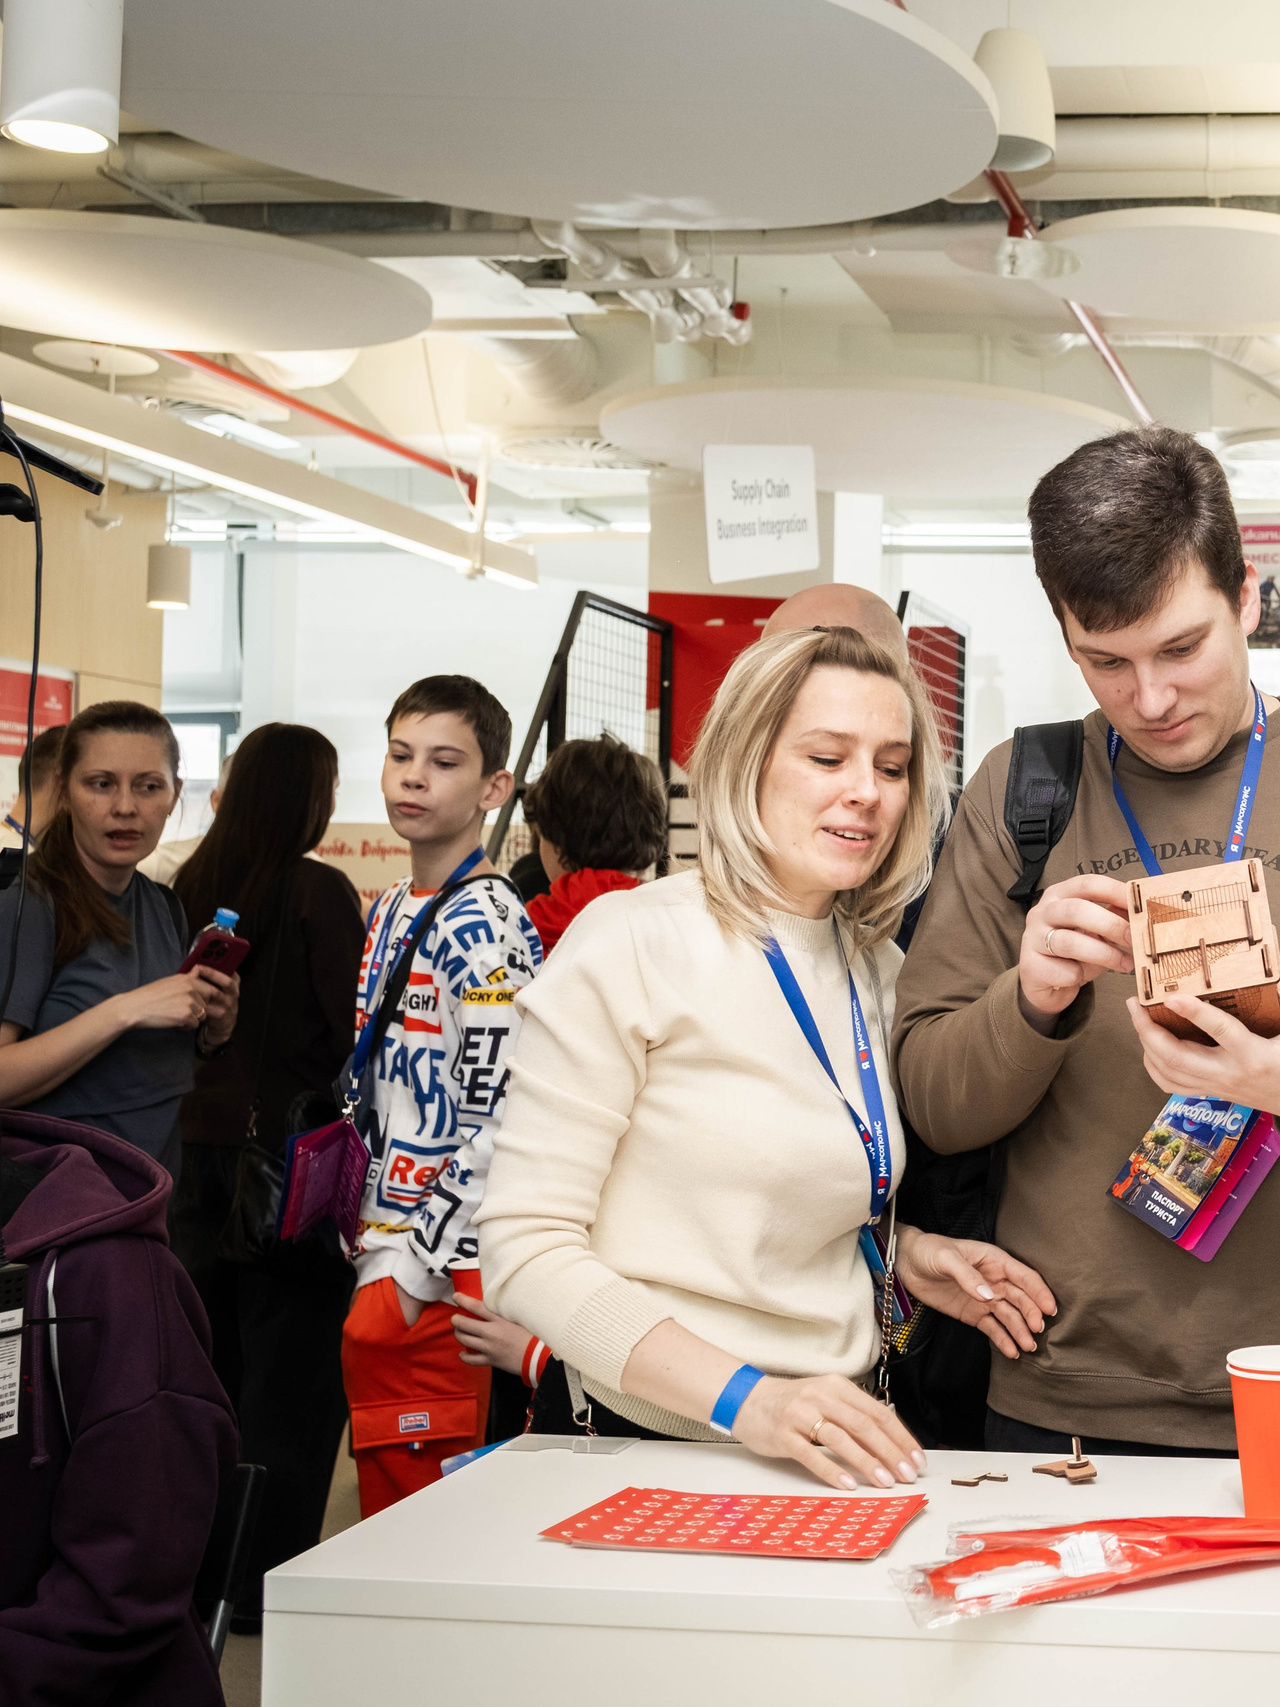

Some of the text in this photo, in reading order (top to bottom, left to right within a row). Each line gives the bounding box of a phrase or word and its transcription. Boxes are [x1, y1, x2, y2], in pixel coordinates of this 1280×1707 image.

[731, 477, 790, 505] Supply Chain
[717, 512, 808, 540] Business Integration
[1165, 1101, 1243, 1131] МАРСОПОЛИС
[1144, 1199, 1177, 1227] ТУРИСТА
[1151, 1190, 1185, 1216] ПАСПОРТ
